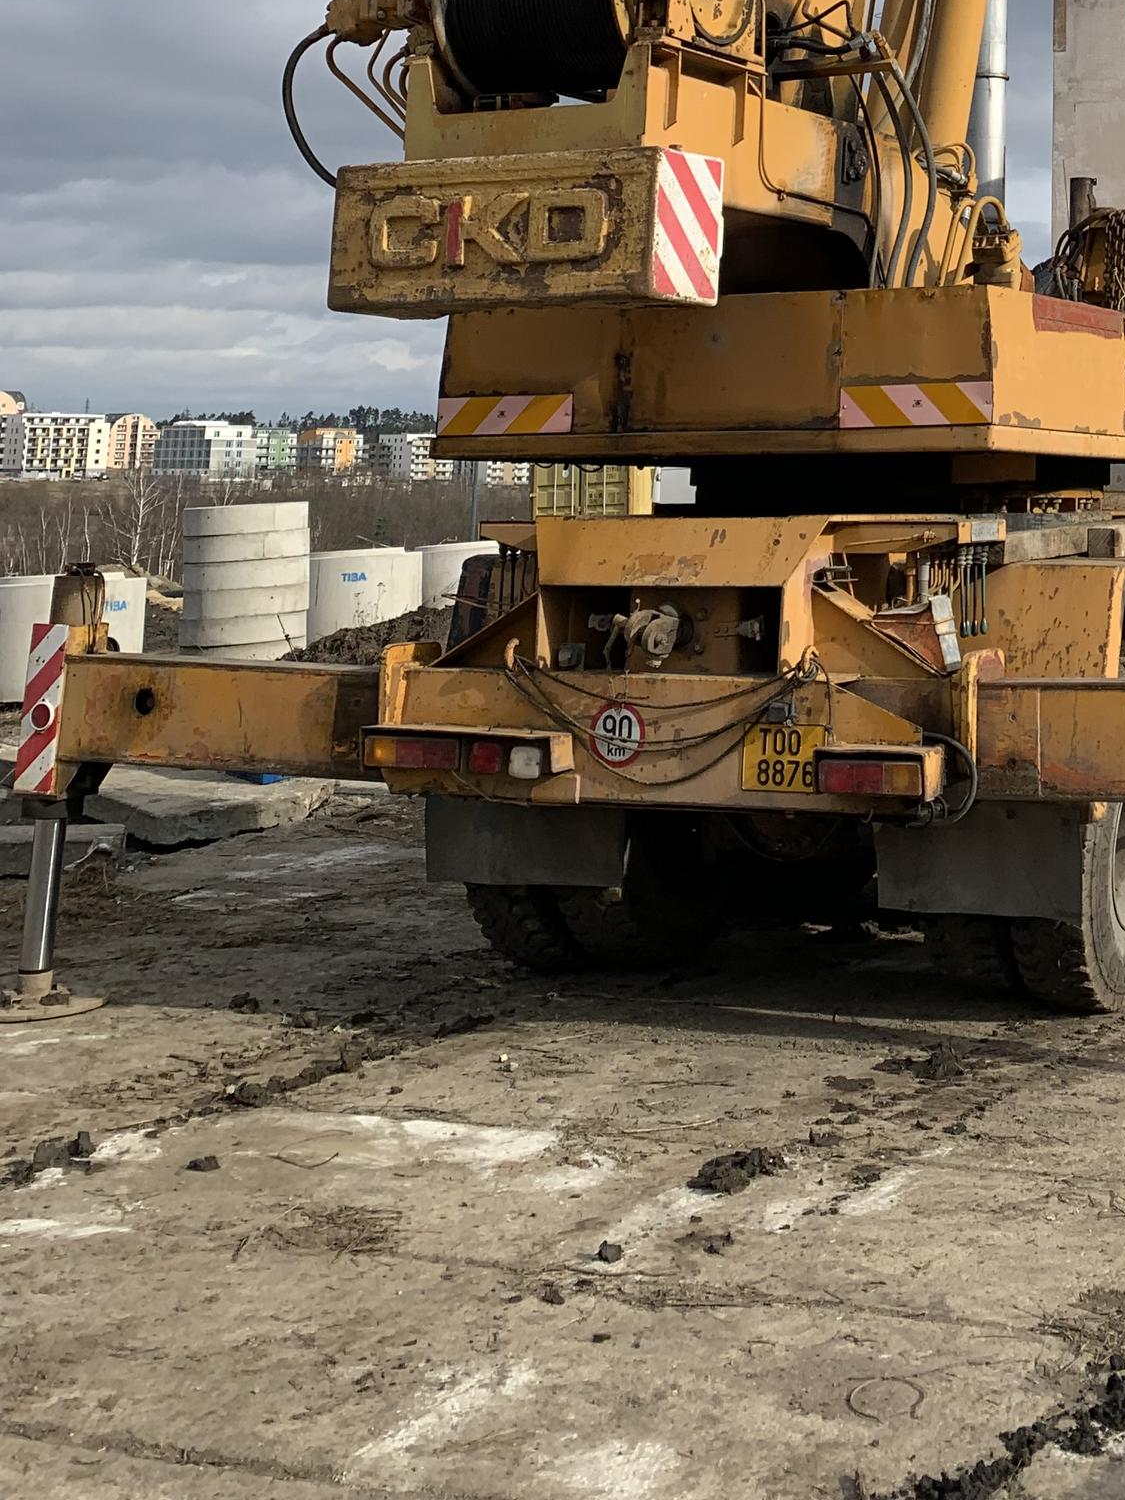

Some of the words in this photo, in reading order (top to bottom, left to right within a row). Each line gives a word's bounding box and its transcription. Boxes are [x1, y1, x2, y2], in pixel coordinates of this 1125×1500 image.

[340, 572, 367, 582] TIBA
[602, 714, 633, 743] 90
[607, 741, 626, 757] km
[757, 758, 814, 788] 8876
